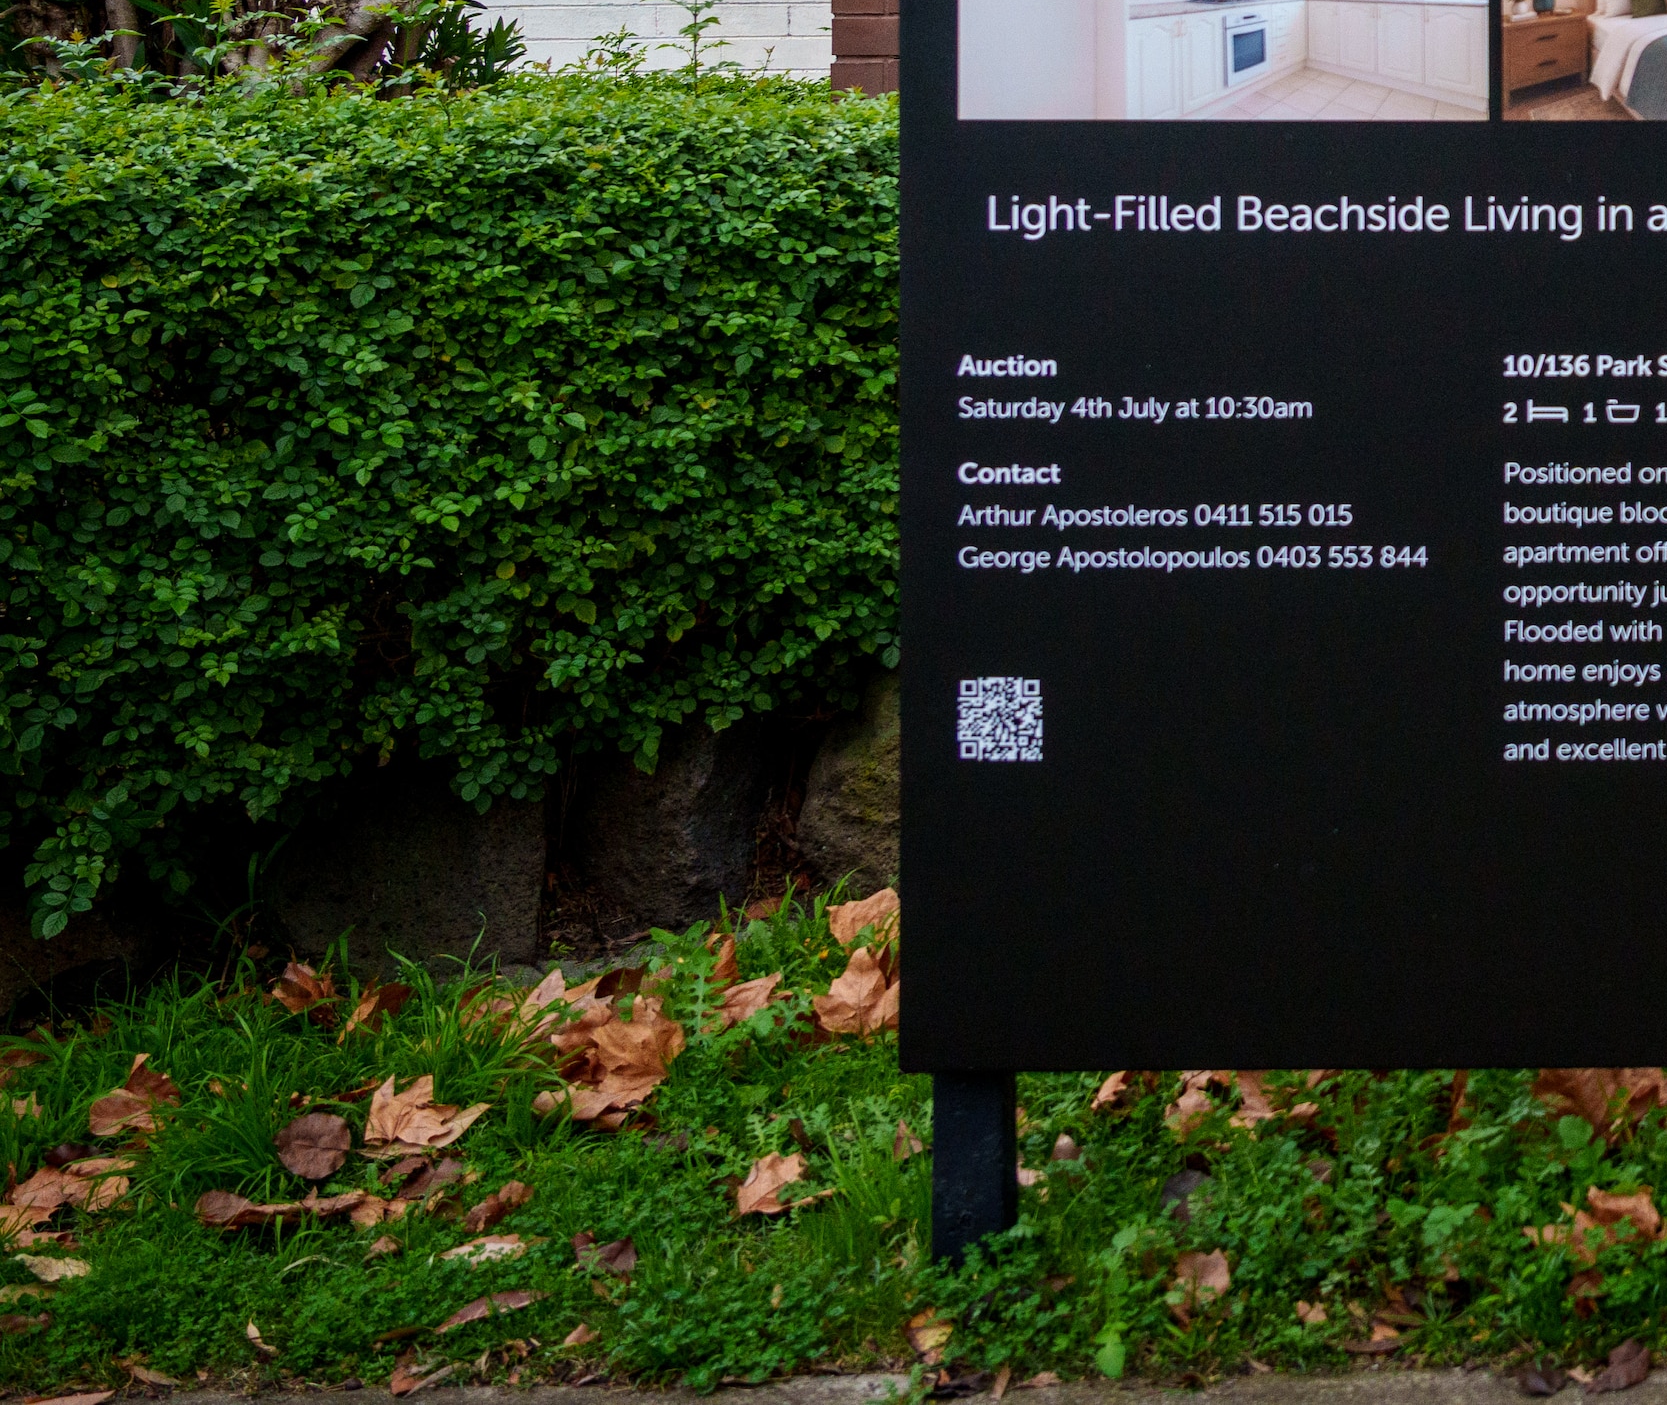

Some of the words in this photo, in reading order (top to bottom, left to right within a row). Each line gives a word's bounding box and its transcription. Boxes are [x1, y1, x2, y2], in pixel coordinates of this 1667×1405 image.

[987, 194, 1222, 241] Light-Filled
[1237, 194, 1451, 233] Beachside
[1464, 195, 1583, 242] Living
[1597, 195, 1634, 232] in
[956, 354, 1058, 378] Auction
[1502, 353, 1591, 378] 10/136
[1595, 354, 1653, 378] Park
[958, 395, 1066, 425] Saturday
[1069, 396, 1113, 419] 4th
[1117, 396, 1171, 425] July
[1174, 398, 1201, 419] at
[1205, 395, 1313, 420] 10:30am
[1502, 401, 1519, 424] 2
[1582, 401, 1598, 424] 1
[957, 461, 1062, 485] Contact
[1504, 461, 1632, 485] Positioned
[957, 504, 1037, 527] Arthur
[1040, 503, 1189, 532] Apostoleros
[1194, 503, 1254, 527] 0411
[1258, 503, 1302, 527] 515
[1307, 503, 1354, 527] 015
[1503, 501, 1614, 529] boutique
[957, 545, 1052, 574] George
[1055, 545, 1251, 574] Apostolopoulos
[1256, 545, 1322, 569] 0403
[1327, 545, 1374, 569] 553
[1379, 545, 1429, 569] 844
[1502, 542, 1631, 569] apartment
[1502, 579, 1648, 608] opportunity
[1504, 619, 1604, 643] Flooded
[1609, 619, 1663, 643] with
[1503, 659, 1577, 683] home
[1581, 658, 1662, 687] enjoys
[1502, 698, 1651, 726] atmosphere
[1503, 737, 1550, 762] and
[1555, 737, 1667, 761] excellent
